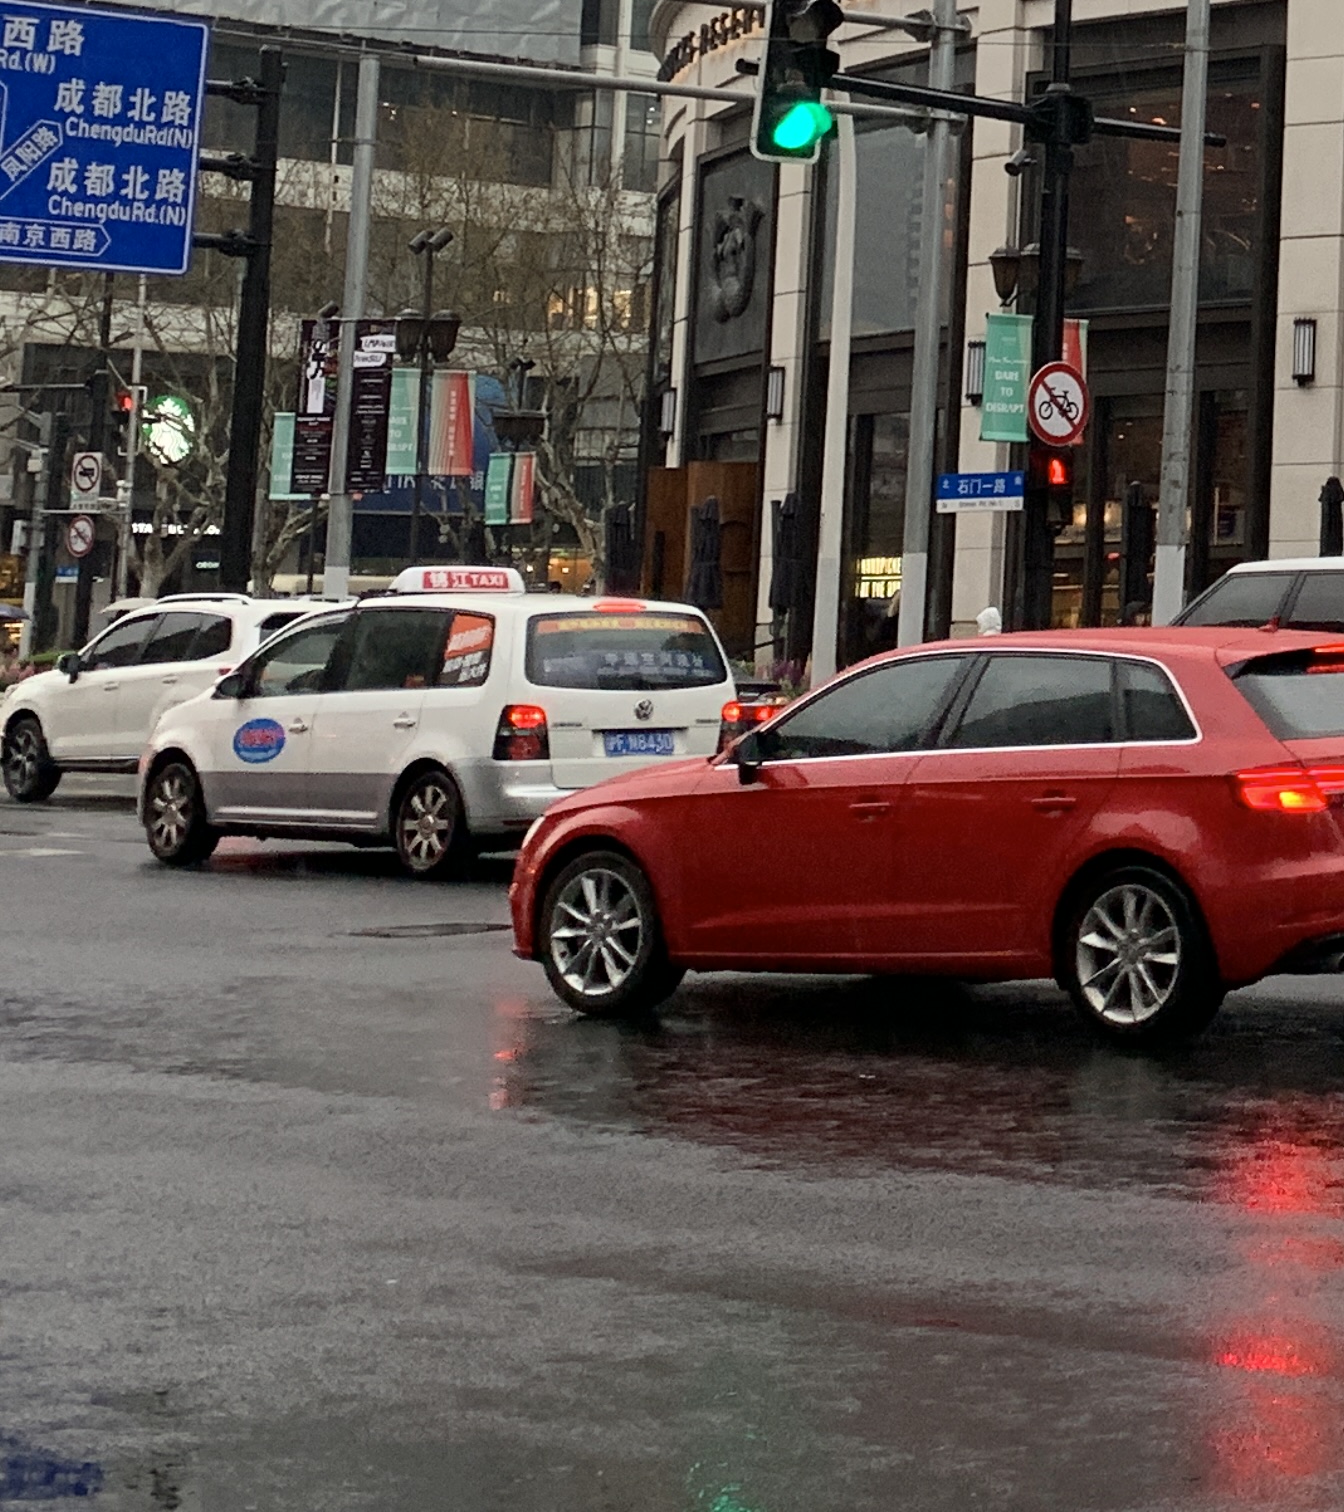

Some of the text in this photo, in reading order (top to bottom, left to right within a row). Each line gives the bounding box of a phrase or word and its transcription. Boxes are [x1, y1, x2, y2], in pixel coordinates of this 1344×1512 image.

[3, 14, 85, 57] 西路
[54, 78, 193, 127] 成都北路
[47, 157, 186, 205] 成都北路
[0, 222, 97, 252] 南京西路
[1000, 386, 1014, 397] TO
[957, 478, 1006, 495] 石门一路
[470, 574, 504, 587] TAXI
